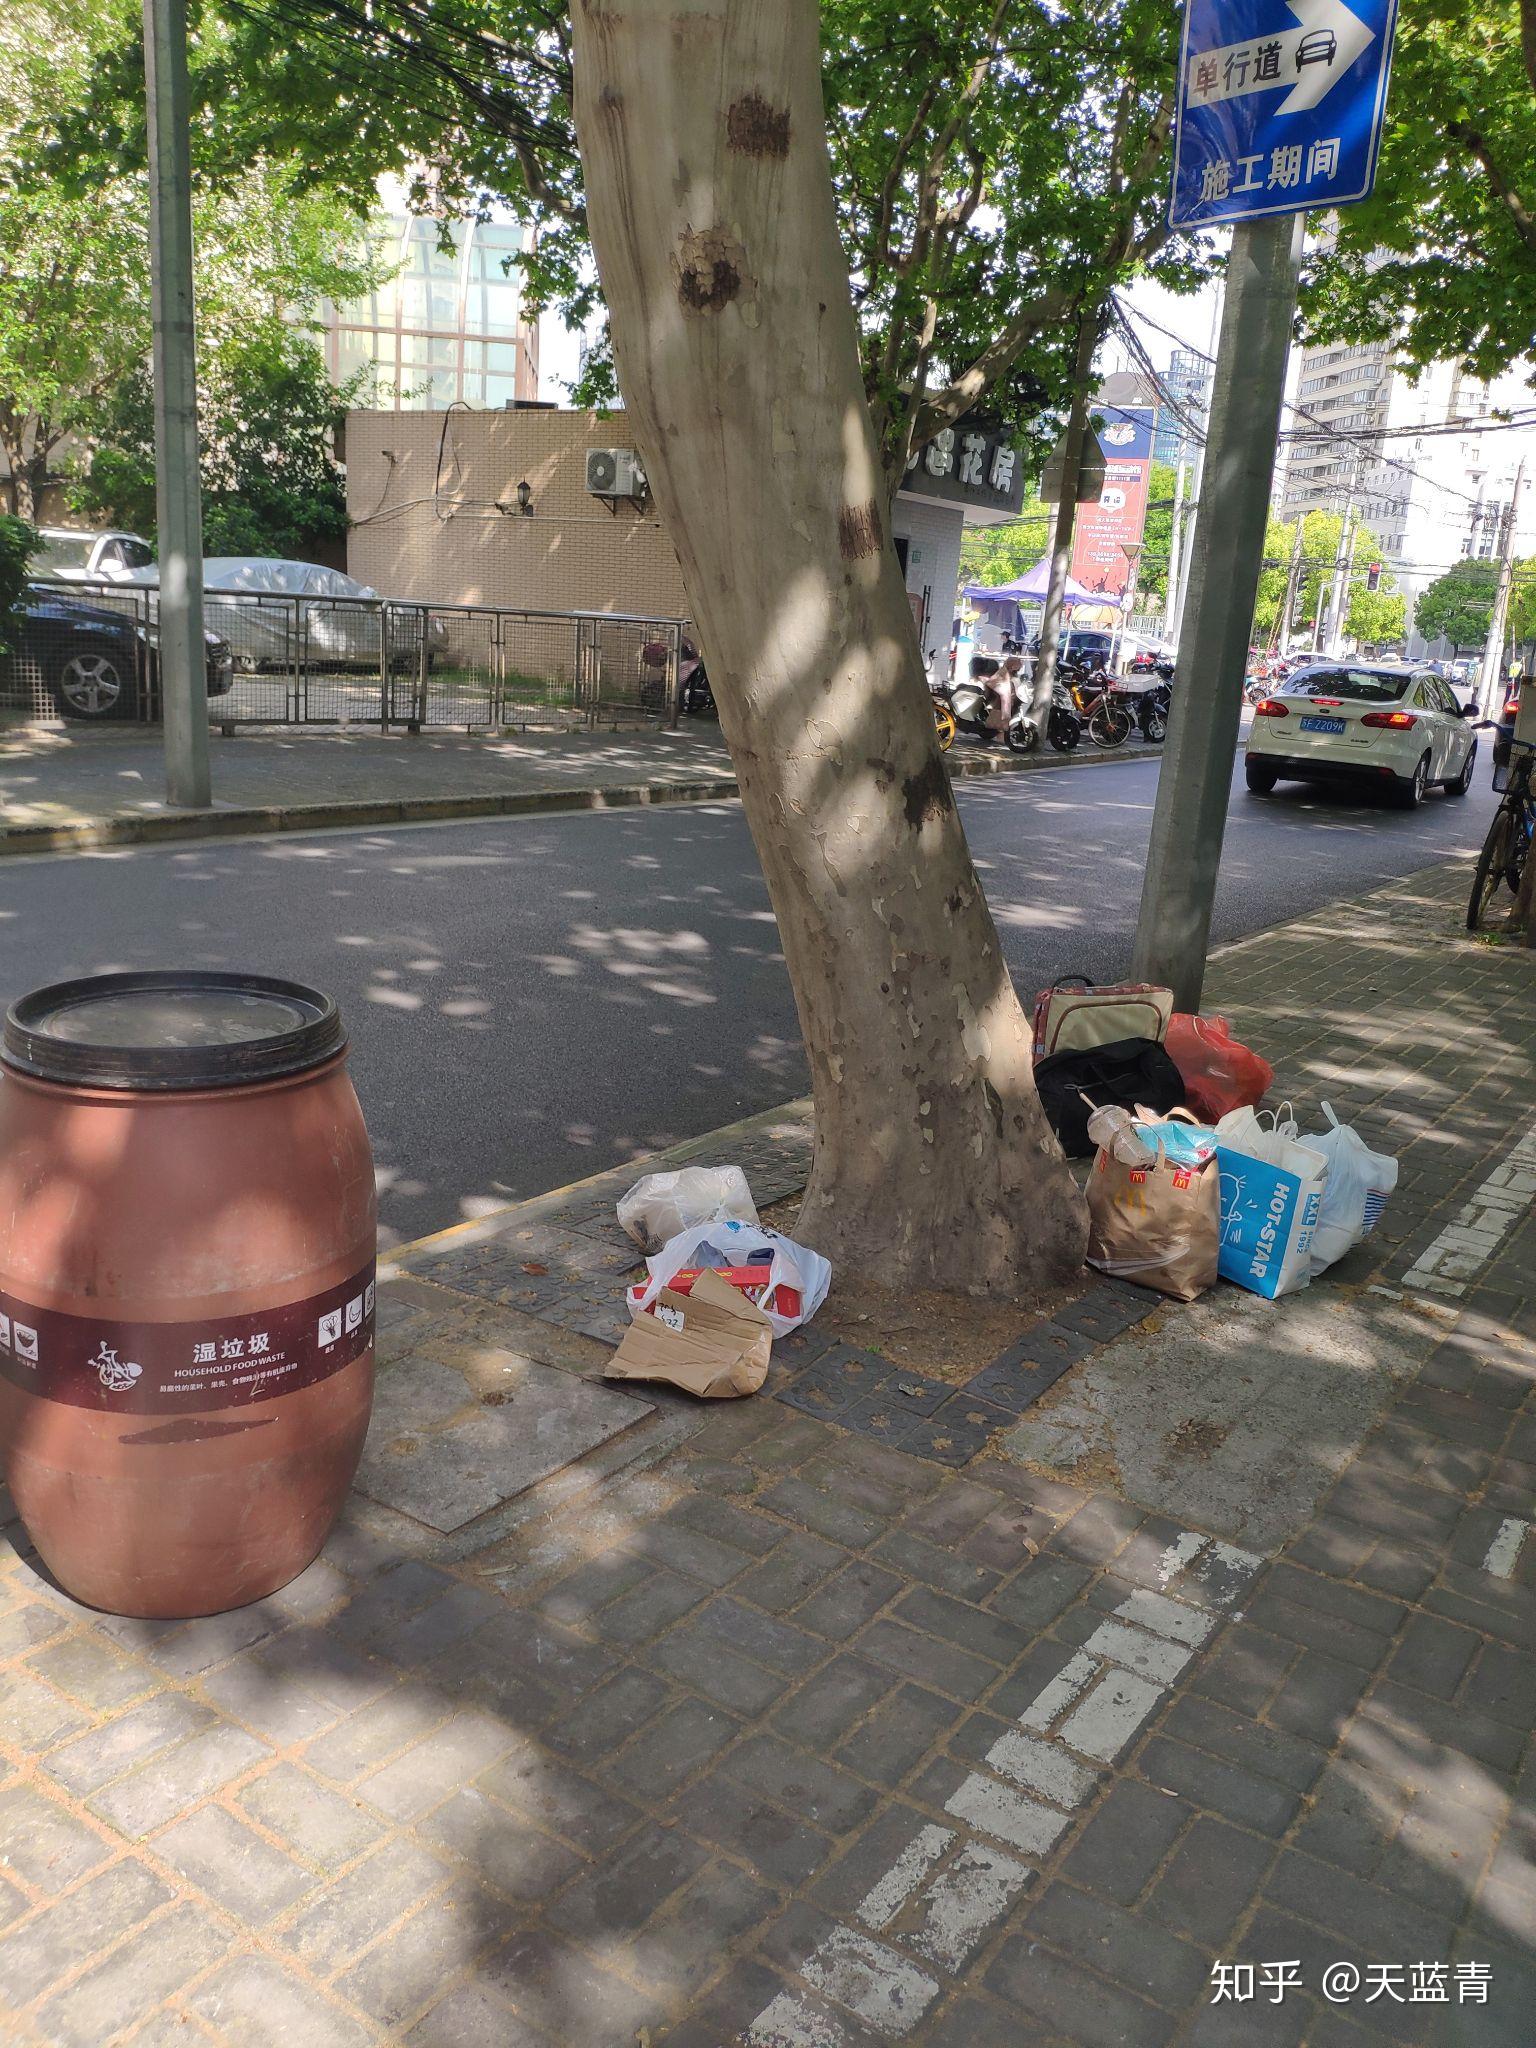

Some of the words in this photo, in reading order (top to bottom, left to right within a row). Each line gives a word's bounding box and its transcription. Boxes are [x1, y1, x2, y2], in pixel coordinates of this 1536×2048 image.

[1193, 40, 1283, 98] 单行道
[1200, 137, 1342, 202] 施工期间
[1249, 1182, 1291, 1278] HOT-STAR
[1305, 1195, 1321, 1225] XXL
[174, 1363, 232, 1378] HOUSEHOLD
[232, 1358, 258, 1371] FOOD
[258, 1351, 286, 1365] WASTE
[192, 1332, 270, 1364] 湿垃圾
